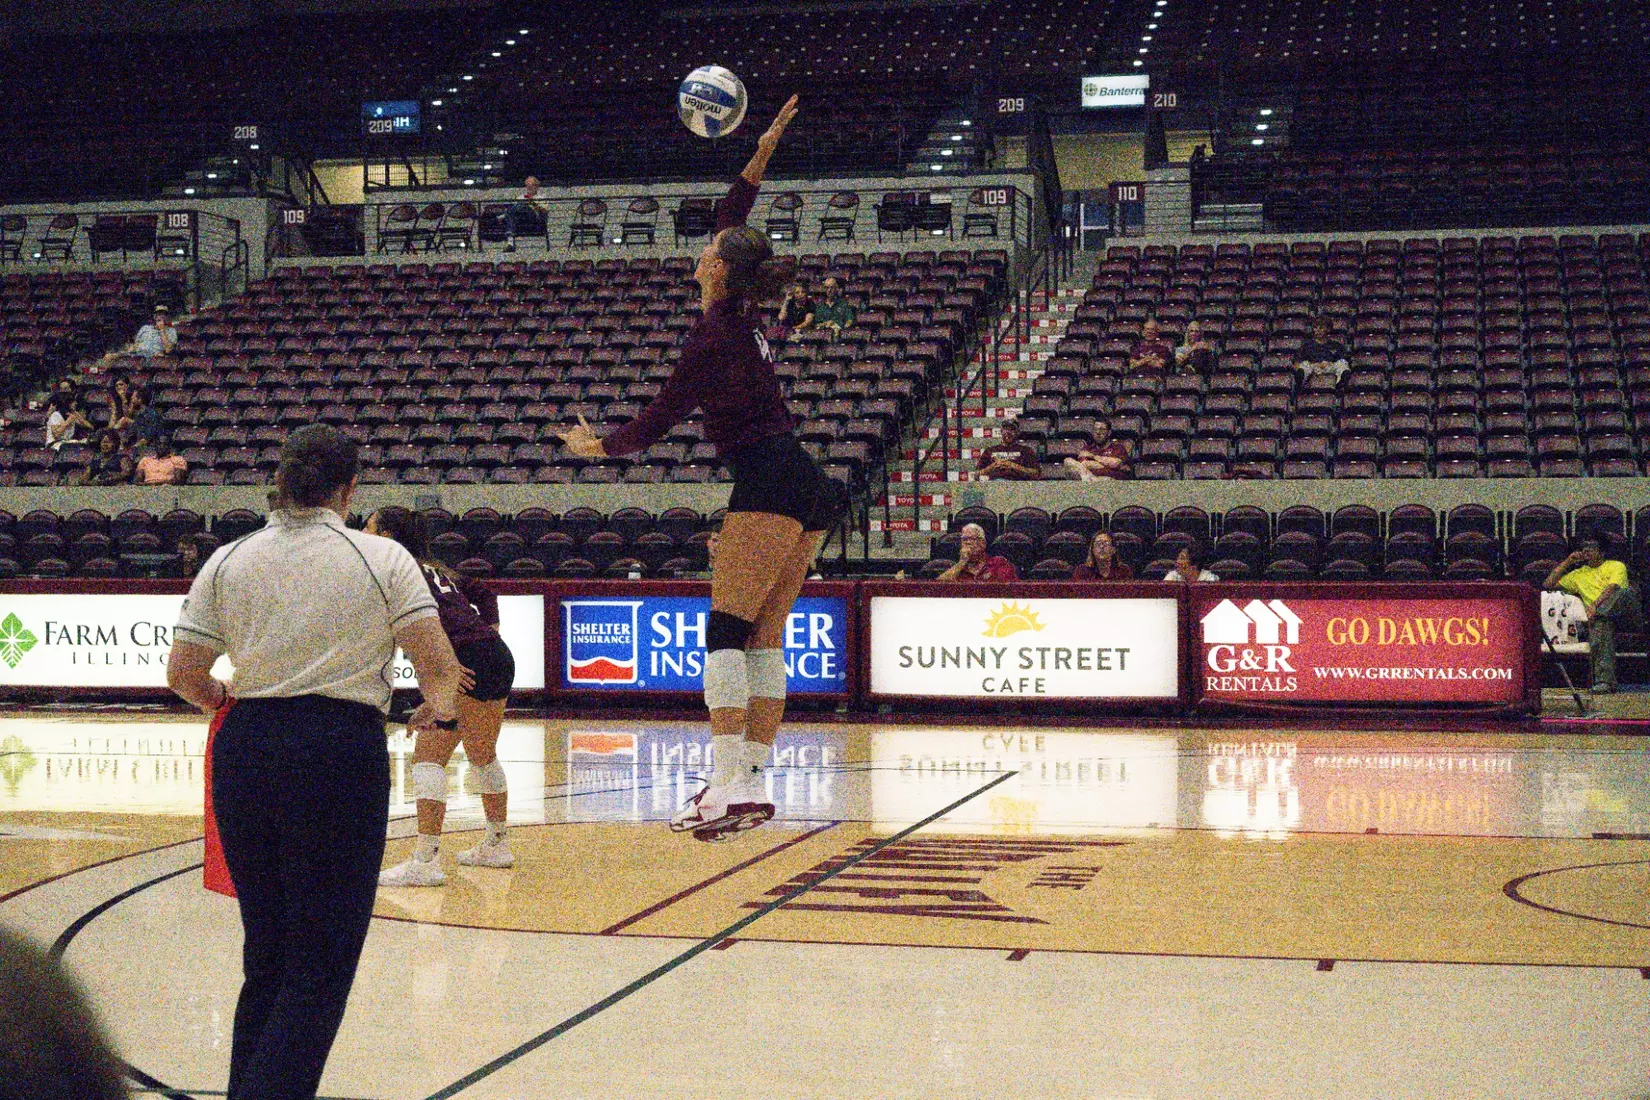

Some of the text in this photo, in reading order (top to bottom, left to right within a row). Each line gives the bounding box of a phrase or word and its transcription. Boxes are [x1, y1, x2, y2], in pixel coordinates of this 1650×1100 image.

[1100, 87, 1145, 96] Banterra
[684, 96, 722, 114] molten
[998, 98, 1024, 112] 209
[1154, 94, 1177, 107] 210
[234, 126, 257, 139] 208
[368, 120, 392, 133] 209
[982, 190, 1006, 204] 109
[1118, 187, 1137, 200] 110
[168, 213, 188, 227] 108
[283, 210, 304, 224] 109
[44, 621, 118, 646] FARM
[572, 623, 631, 635] SHELTER
[651, 612, 836, 649] SHER
[1327, 617, 1490, 645] GO DAWGS!
[572, 635, 632, 645] INSURANCE
[650, 651, 836, 679] INSNCE
[899, 646, 1131, 671] SUNNY STREET
[1207, 644, 1297, 672] G&R
[1313, 666, 1513, 680] WWW.GRRENTALS.COM
[981, 677, 1046, 693] CAFE
[1206, 677, 1297, 692] RENTALS
